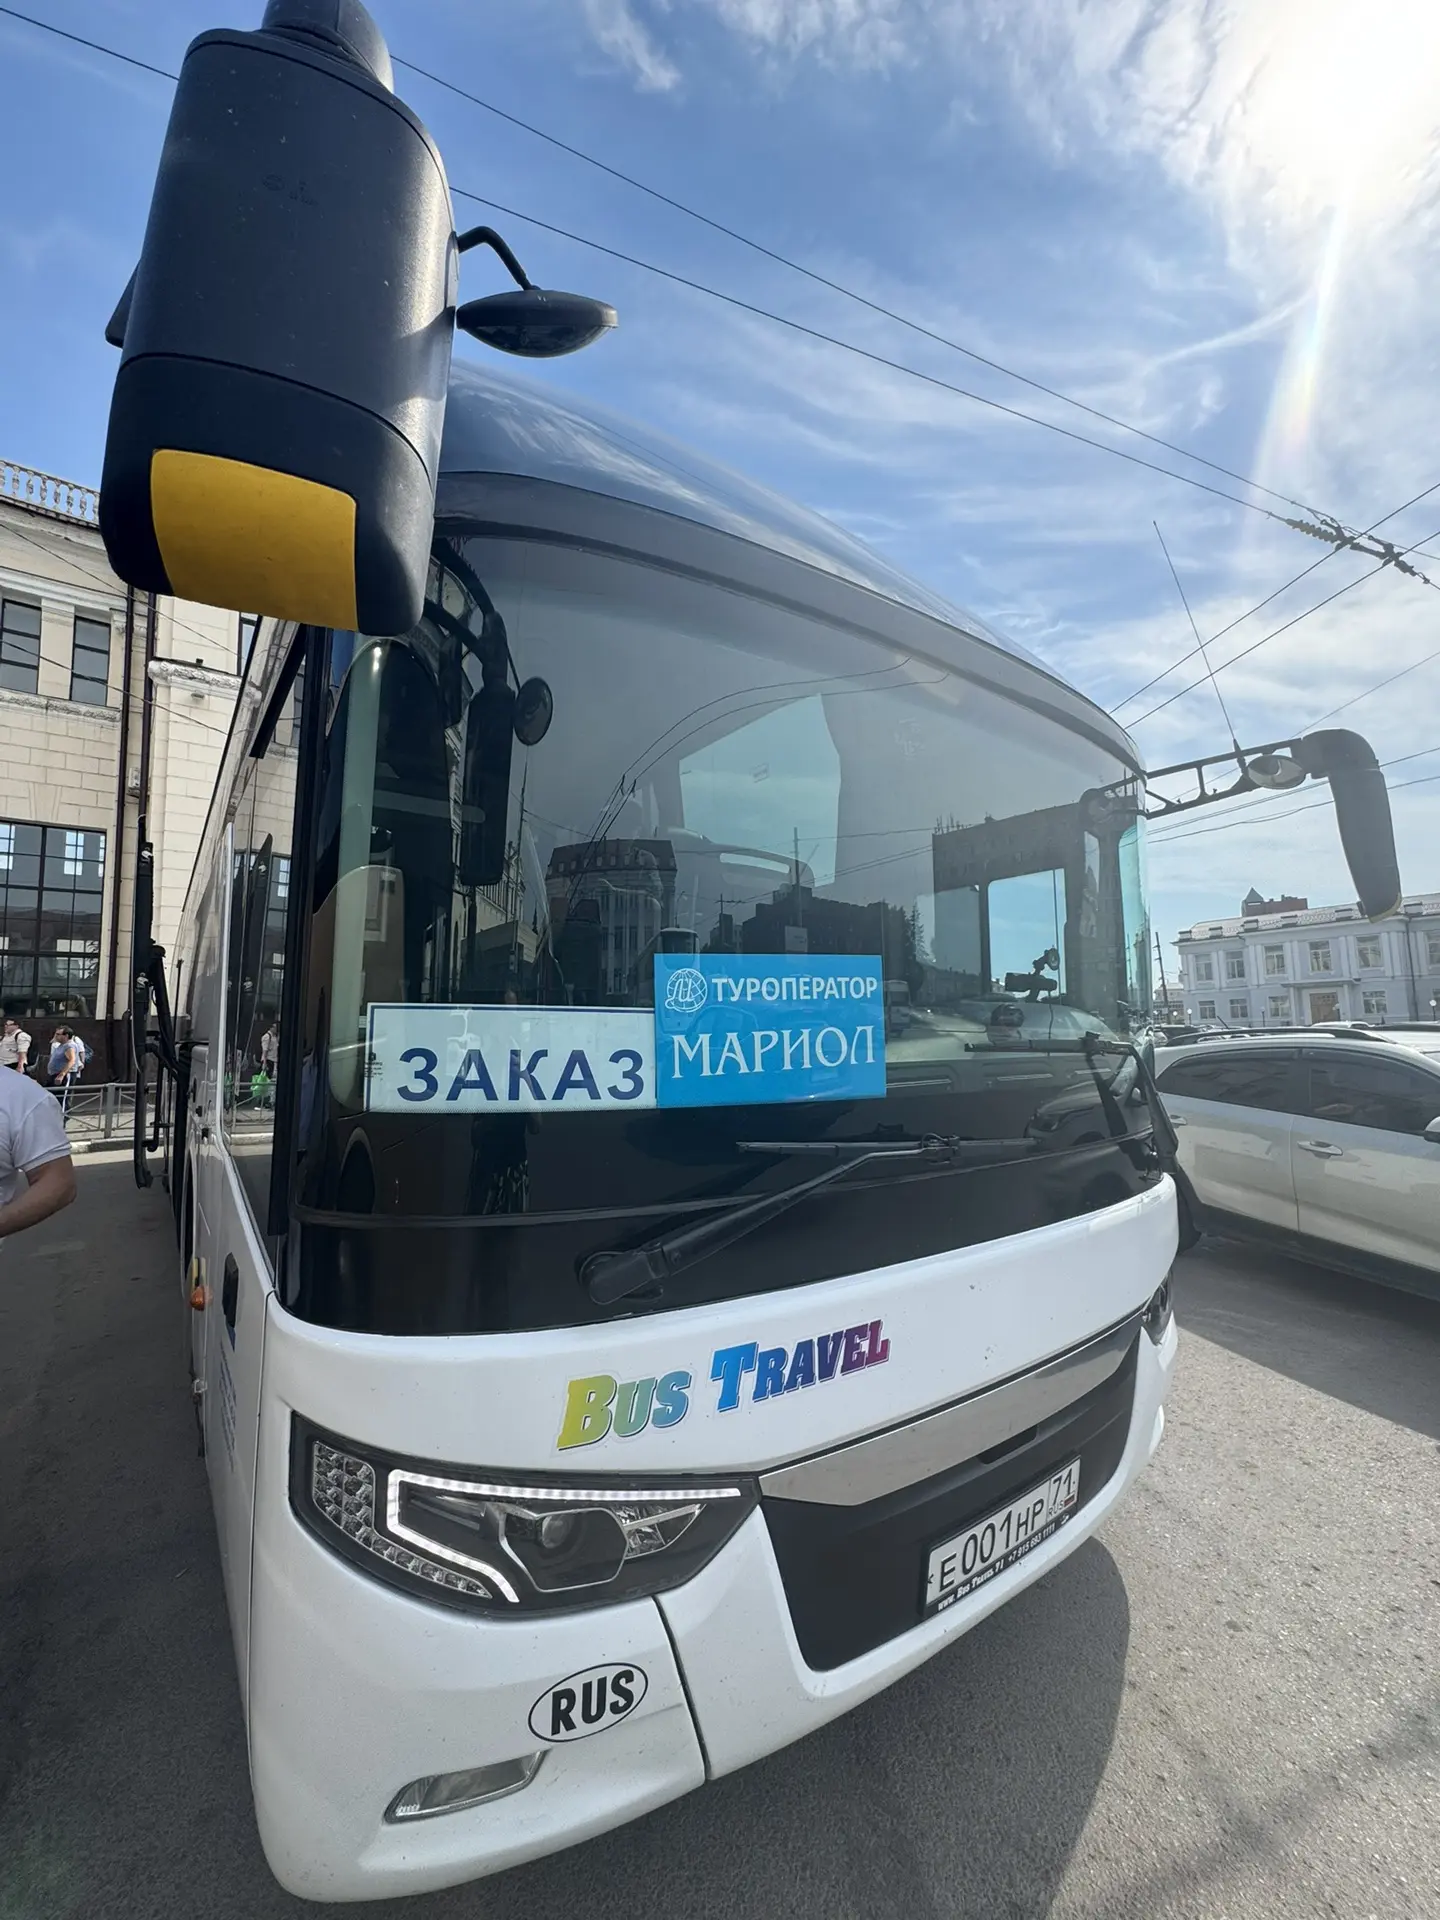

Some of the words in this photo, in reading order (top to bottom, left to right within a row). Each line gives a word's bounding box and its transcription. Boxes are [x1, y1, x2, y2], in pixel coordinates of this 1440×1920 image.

[711, 976, 878, 1004] ТУРОПЕРАТОР
[396, 1047, 644, 1102] ЗАКАЗ
[672, 1025, 876, 1079] МАРИОЛ
[1053, 1467, 1073, 1506] 71
[551, 1669, 635, 1737] RUS
